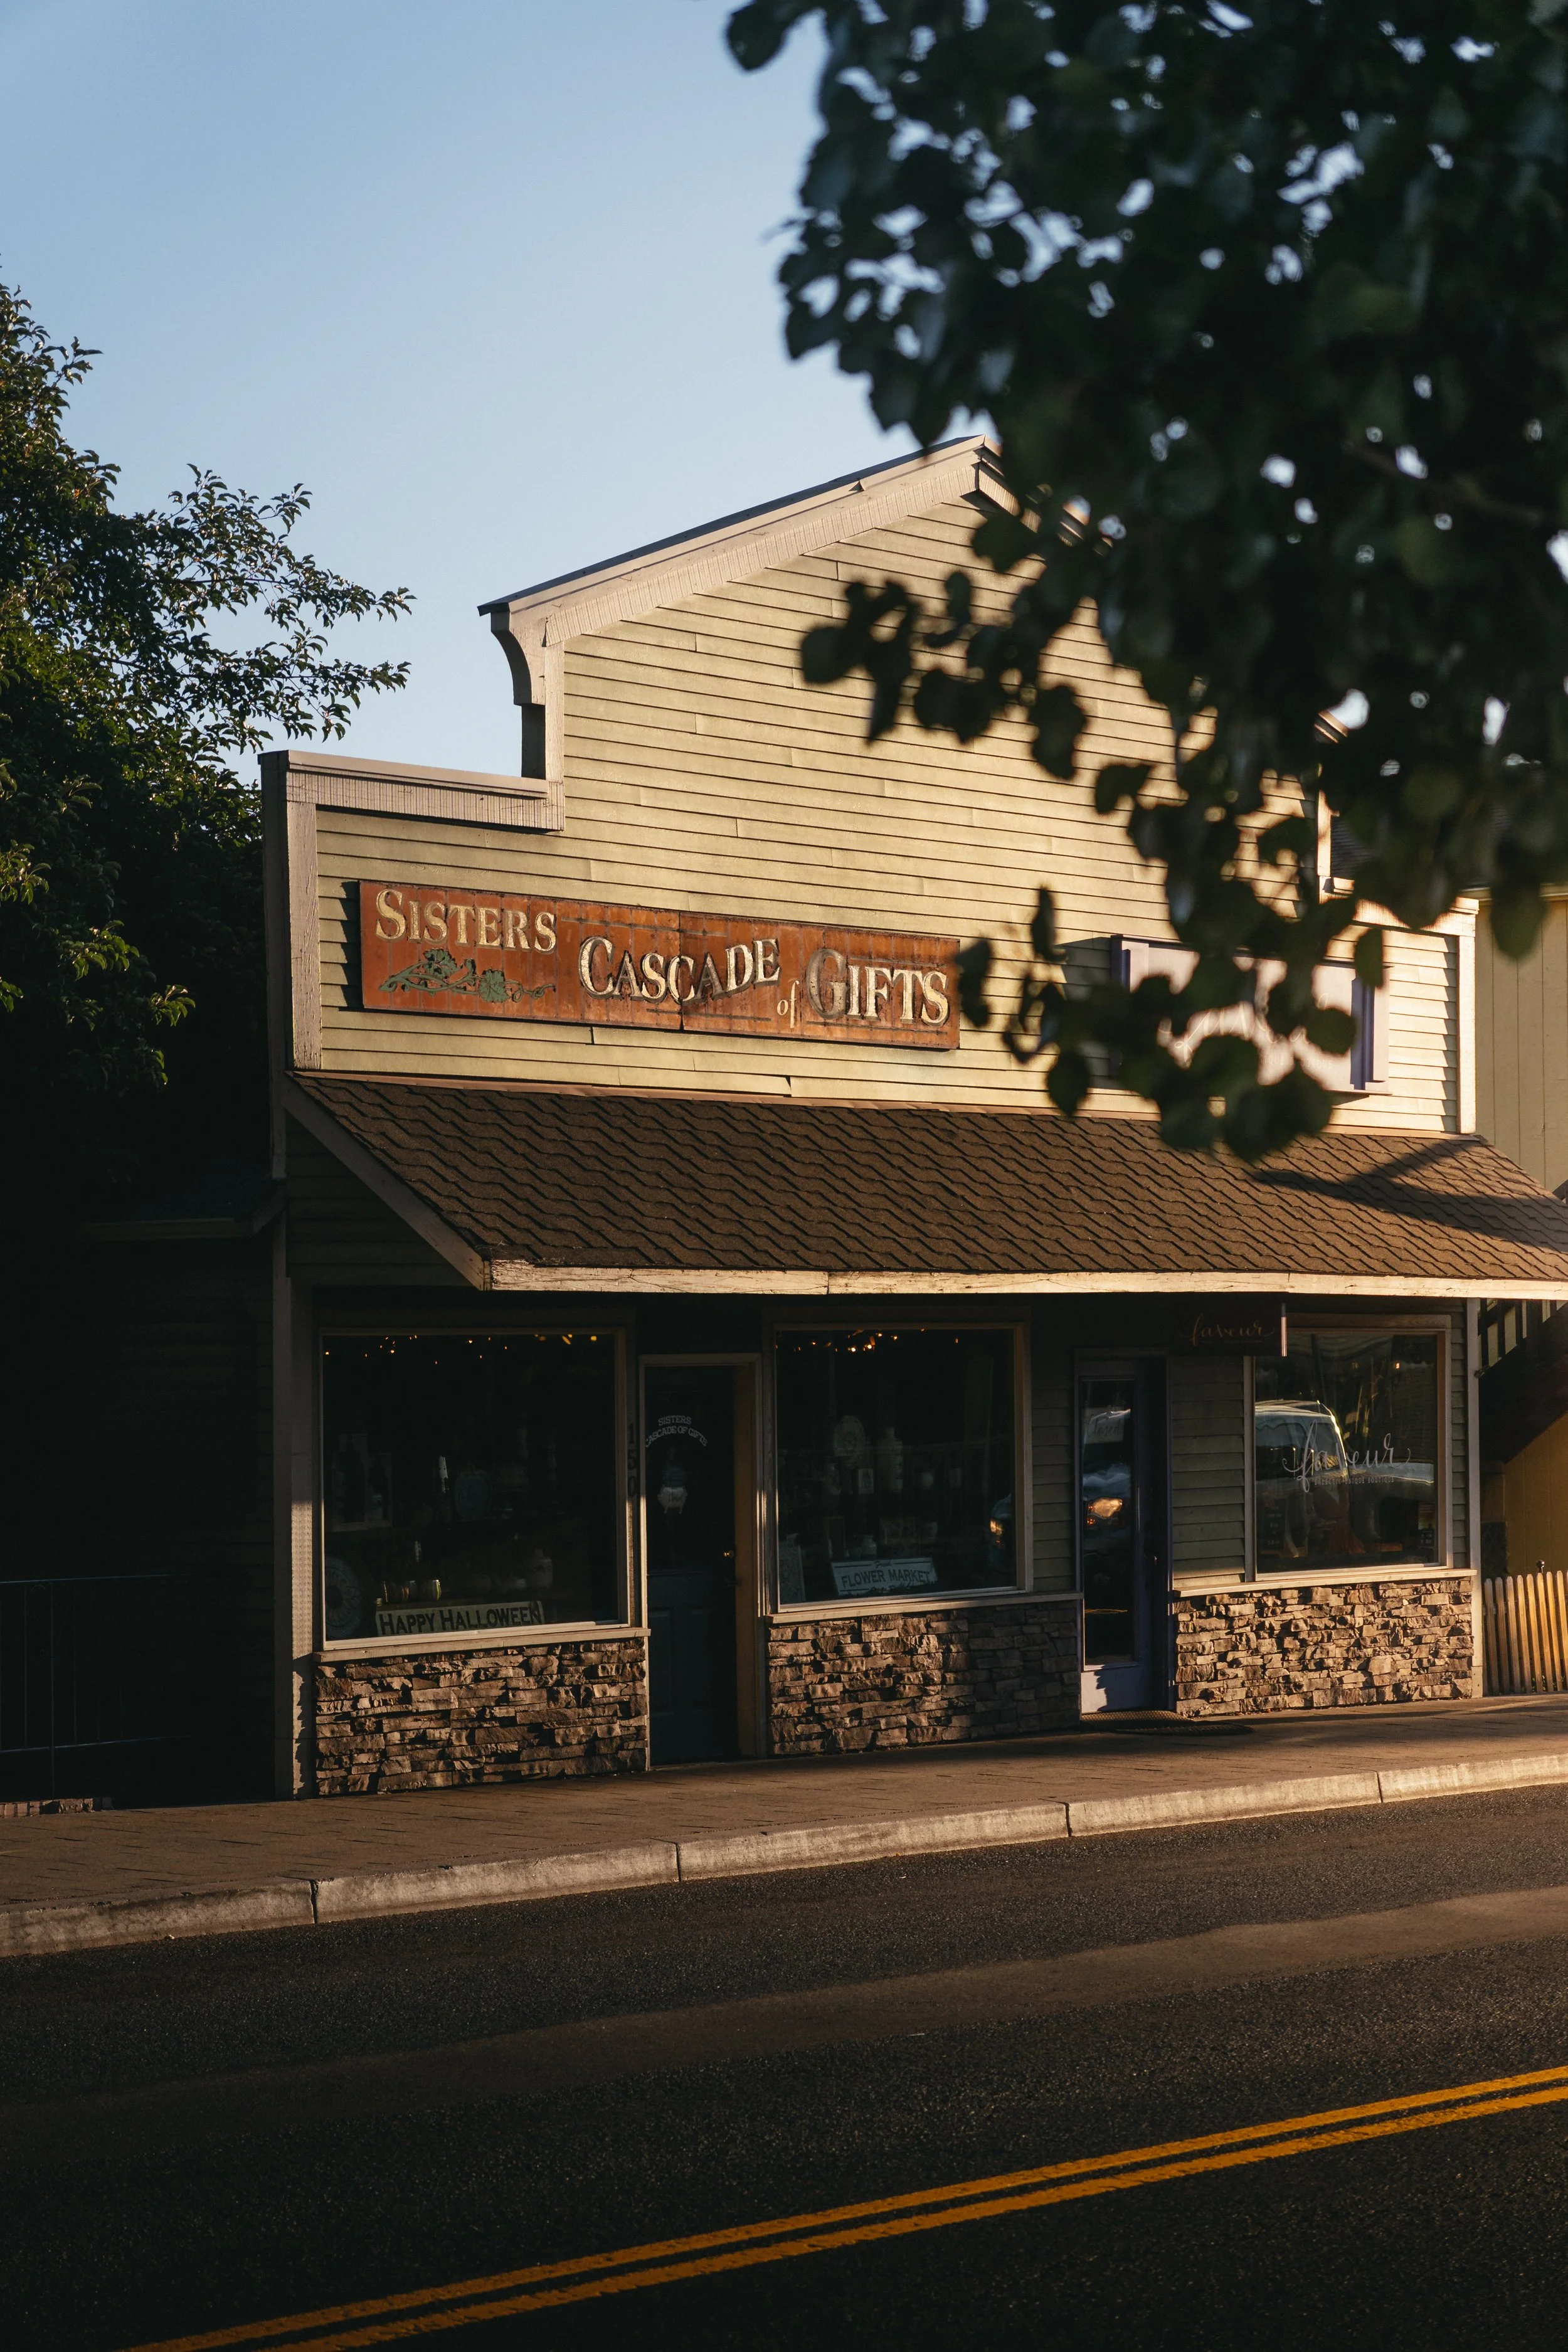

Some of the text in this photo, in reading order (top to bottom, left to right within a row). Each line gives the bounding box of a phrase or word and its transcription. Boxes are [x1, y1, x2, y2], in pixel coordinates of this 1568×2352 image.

[376, 888, 557, 954] SISTERS
[578, 936, 950, 1029] CASCADE of GIFTS
[658, 1415, 692, 1426] SISTERS
[645, 1426, 707, 1448] CASCADE OF GIFTS
[1367, 1476, 1395, 1484] BOUTIQUE
[841, 1569, 930, 1589] FLOWER MARKET
[379, 1606, 543, 1635] HAPPY HALLOWEEN
